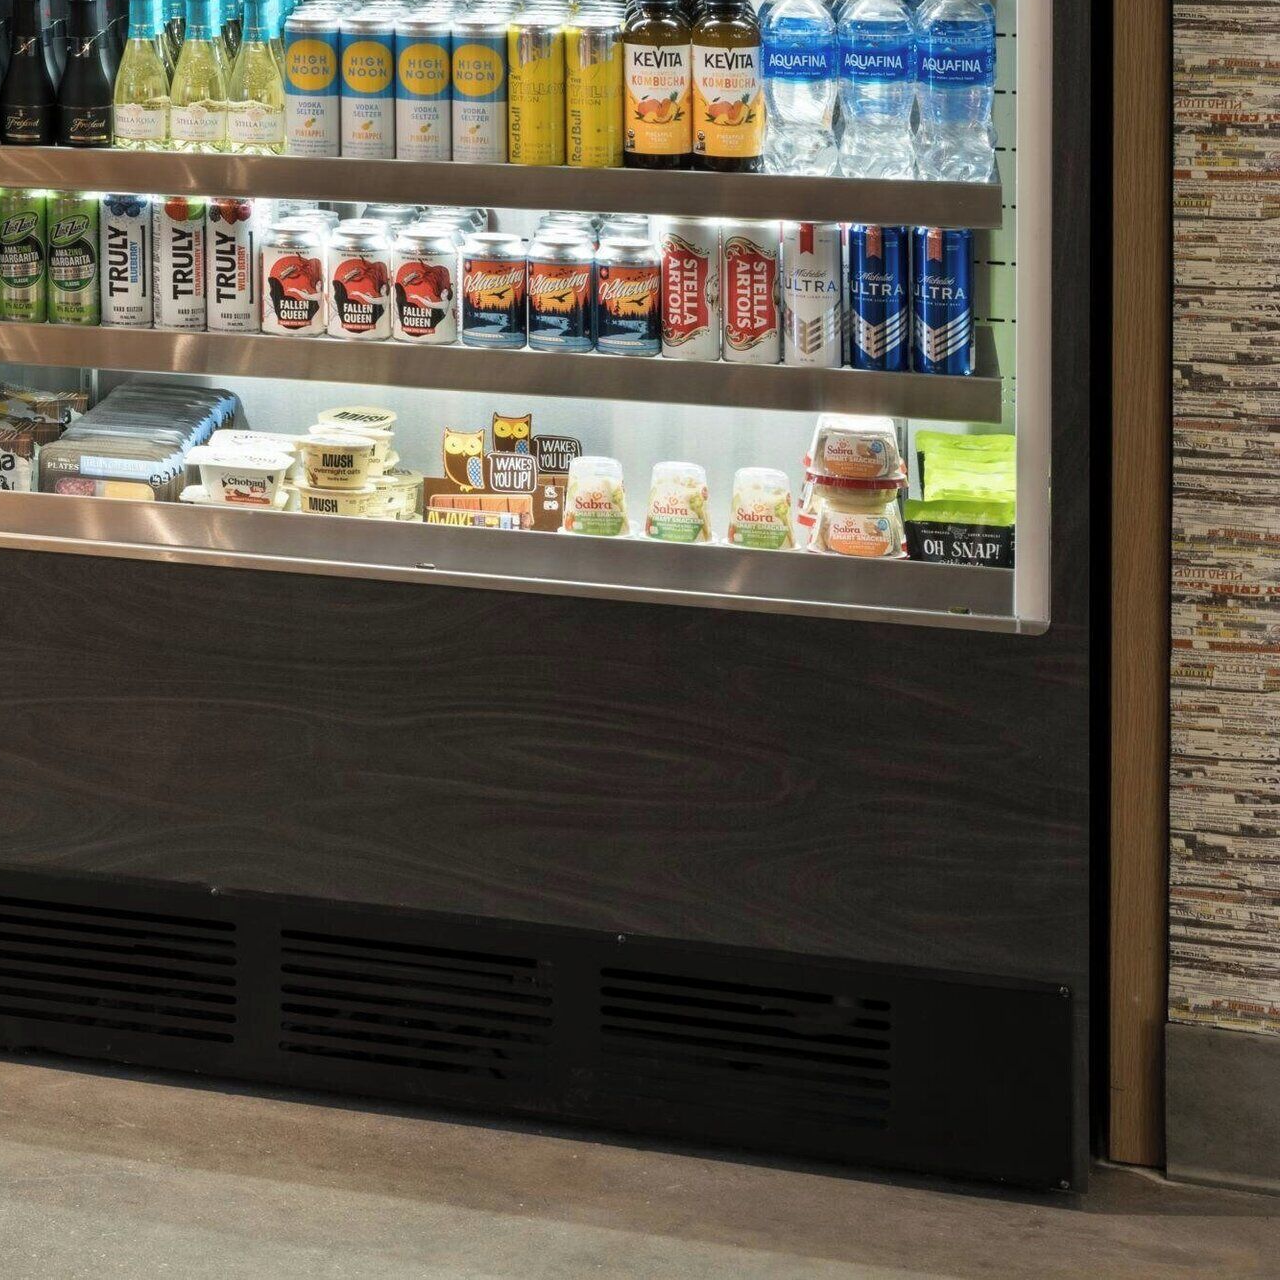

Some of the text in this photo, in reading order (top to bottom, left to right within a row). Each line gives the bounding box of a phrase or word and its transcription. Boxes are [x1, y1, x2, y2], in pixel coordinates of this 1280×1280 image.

[294, 55, 327, 64] HIGH
[351, 57, 383, 66] HIGH
[408, 59, 441, 68] HIGH
[458, 60, 491, 70] HIGH
[634, 51, 682, 69] KEVITA
[705, 53, 753, 71] KEVITA
[769, 53, 827, 69] AQUAFINA
[844, 54, 903, 68] AQUAFINA
[922, 57, 982, 73] AQUAFINA
[292, 66, 329, 75] NOON
[348, 68, 386, 77] NOON
[406, 70, 443, 79] NOON
[456, 72, 494, 81] NOON
[632, 76, 685, 87] KOMBUCHA
[702, 77, 756, 88] KOMBUCHA
[0, 252, 39, 263] MARGARITA
[51, 255, 90, 267] MARGARITA
[108, 225, 128, 297] TRULY
[130, 242, 138, 283] BLUEBERRY
[172, 227, 193, 300] TRULY
[216, 231, 236, 303] TRULY
[237, 246, 246, 291] WILD BERRY
[465, 269, 525, 292] Bluewing
[529, 272, 589, 296] Bluewing
[785, 280, 835, 292] ULTRA
[668, 256, 681, 325] ARTOIS
[684, 259, 698, 325] STELLA
[737, 259, 751, 328] ARTOIS
[753, 261, 767, 328] STELLA
[851, 282, 903, 296] ULTRA
[280, 300, 309, 310] FALLEN
[343, 303, 373, 314] FALLEN
[280, 309, 308, 320] QUEEN
[343, 313, 372, 324] QUEEN
[403, 307, 431, 318] FALLEN
[403, 317, 431, 328] QUEEN
[543, 440, 576, 453] WAKES
[827, 445, 853, 455] Sabra
[47, 462, 79, 471] PLATES
[322, 453, 354, 468] MUSH
[496, 455, 533, 472] WAKES
[541, 453, 558, 467] YOU
[313, 467, 360, 477] overnight oats
[228, 477, 266, 491] Chobani
[494, 471, 531, 488] YOU UP!
[308, 497, 338, 513] MUSH
[575, 497, 612, 510] Sabra
[653, 501, 688, 516] Sabra
[737, 508, 773, 523] Sabra
[834, 524, 860, 534] Sabra
[923, 540, 1000, 561] OH SNAP!
